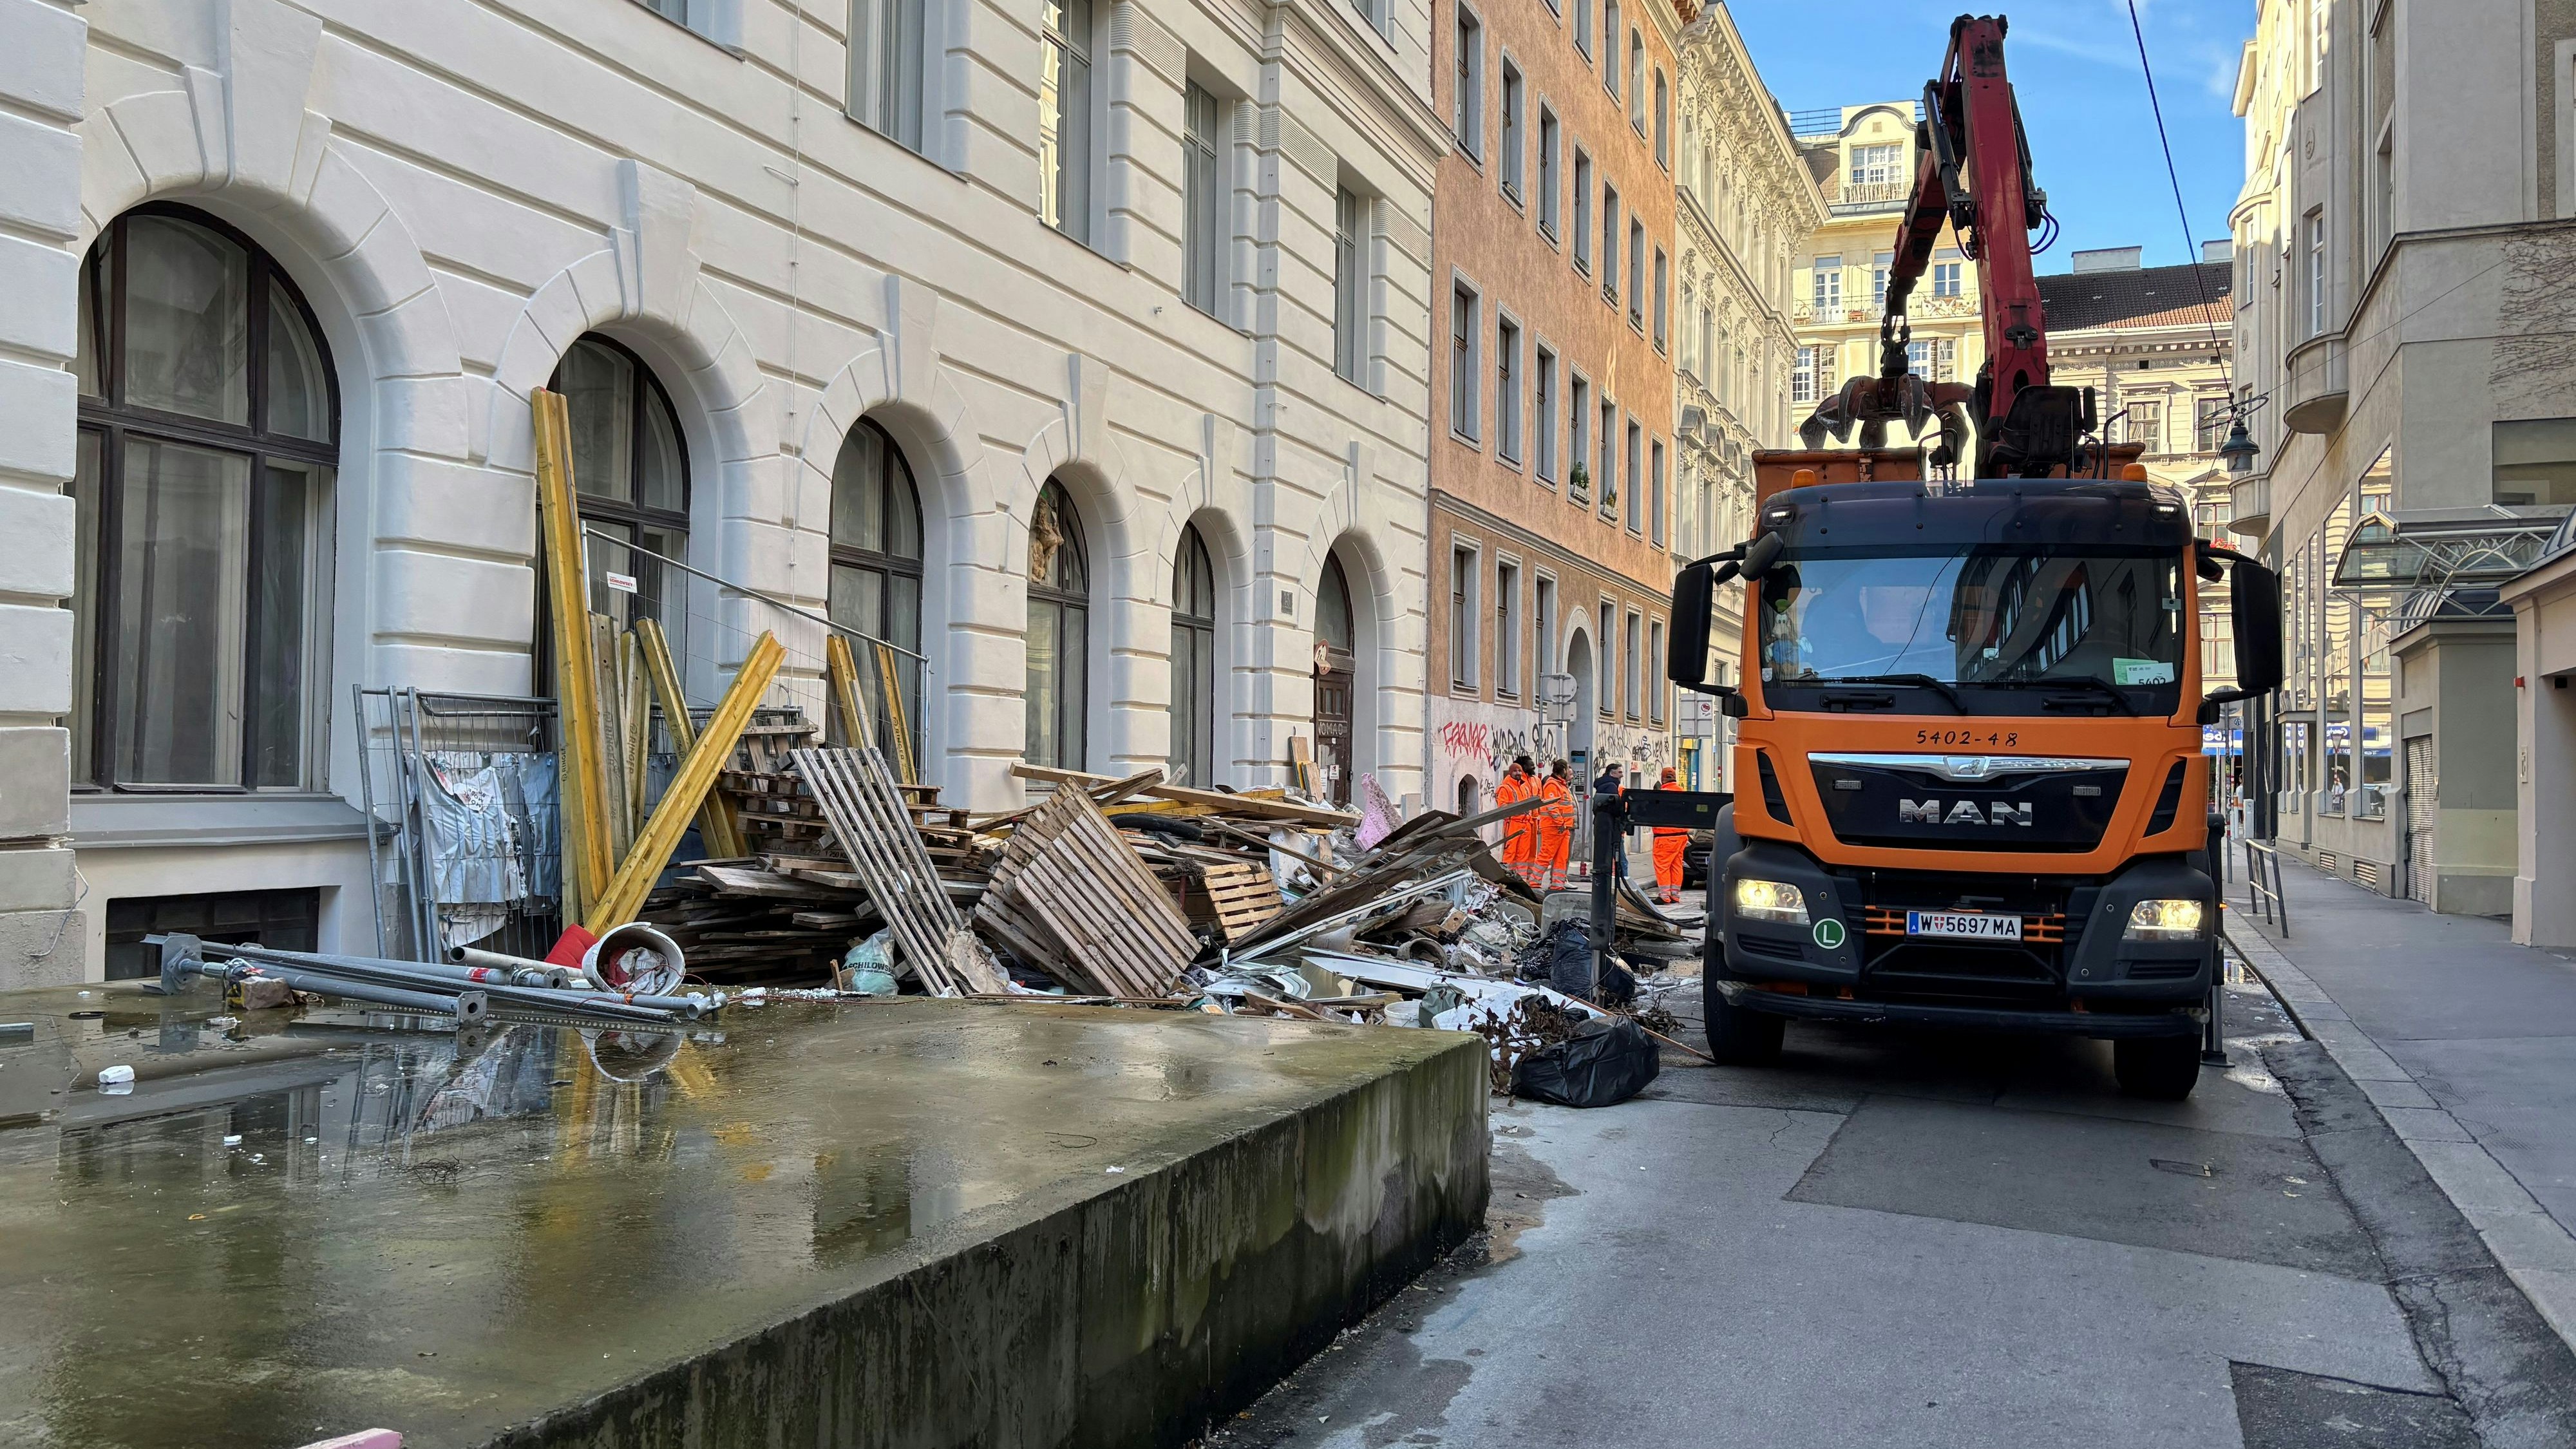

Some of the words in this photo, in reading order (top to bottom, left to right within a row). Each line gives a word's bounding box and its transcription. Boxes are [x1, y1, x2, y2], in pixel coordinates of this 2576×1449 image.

[1900, 799, 2032, 827] MAN
[1823, 924, 1836, 943] L
[1921, 915, 1933, 931] W
[1946, 916, 1989, 934] 5697
[1993, 919, 2016, 936] MA
